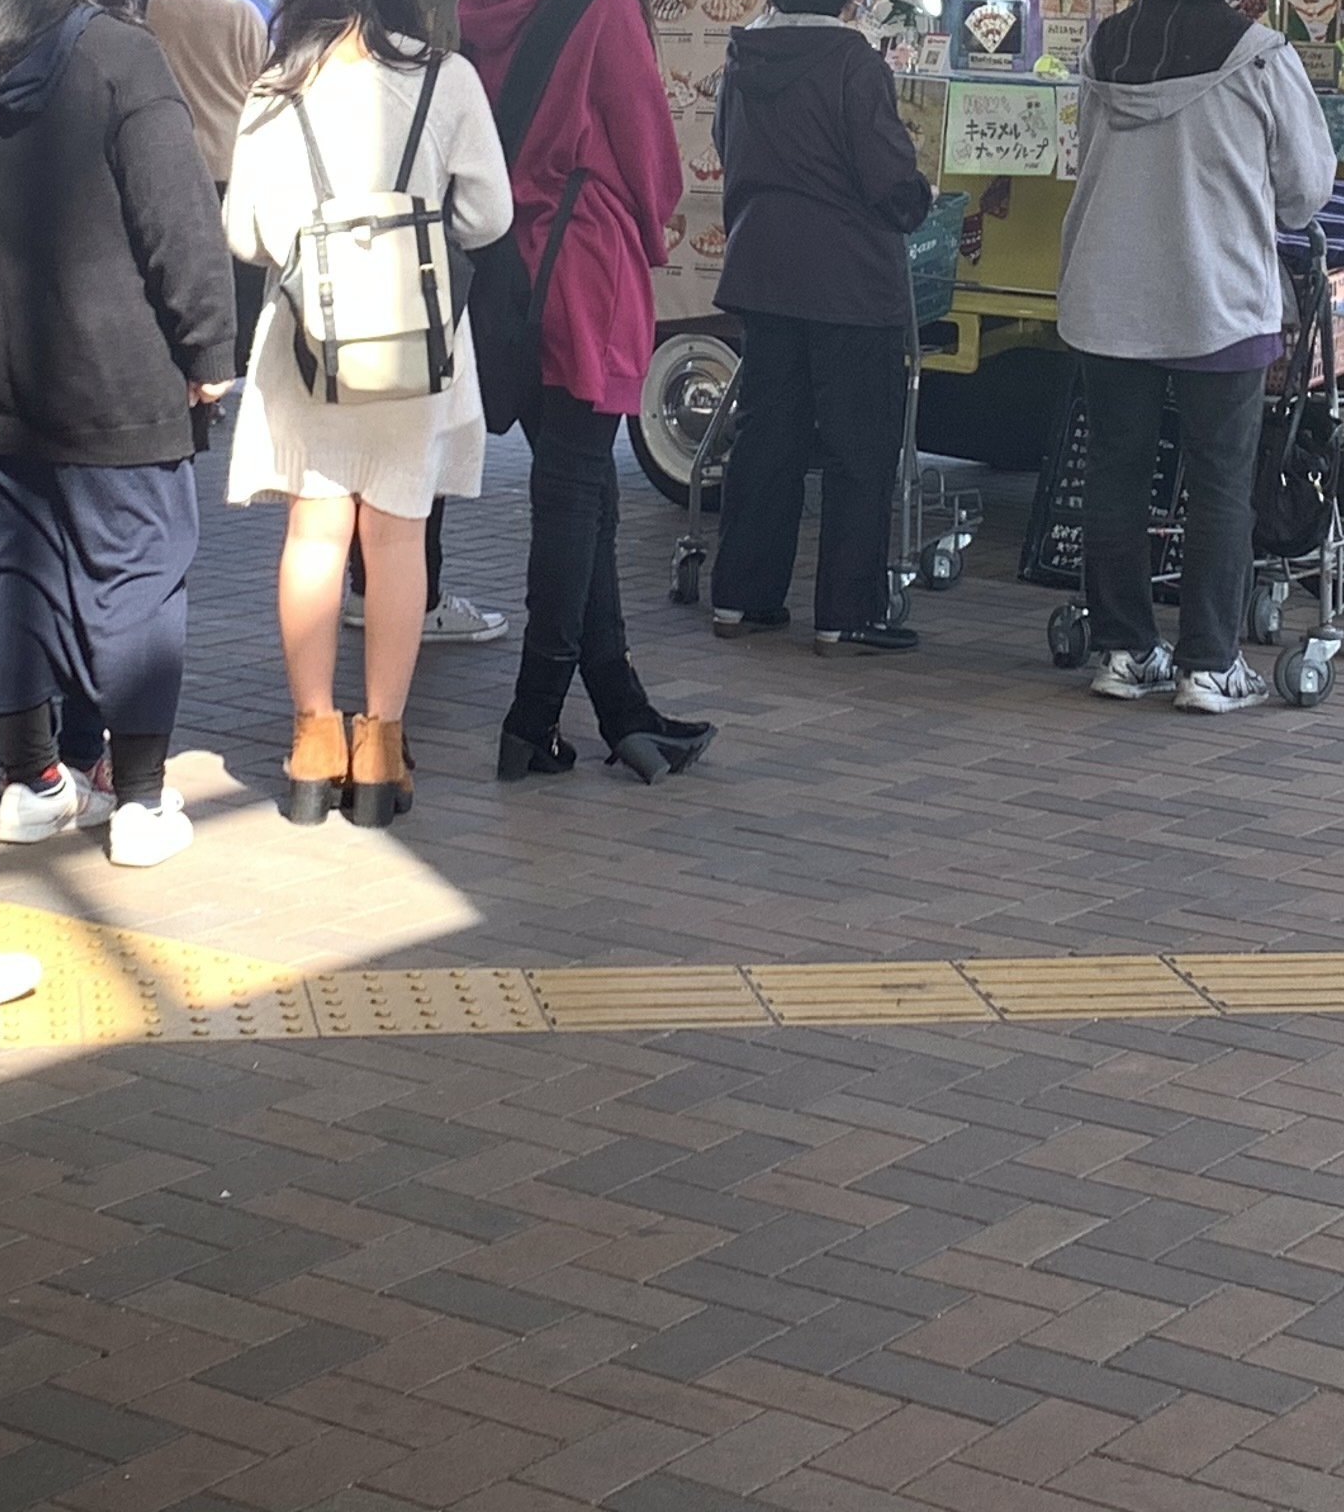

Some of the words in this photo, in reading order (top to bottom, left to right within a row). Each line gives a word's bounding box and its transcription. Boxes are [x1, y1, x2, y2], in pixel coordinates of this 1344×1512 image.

[965, 119, 1022, 141] キャラメル
